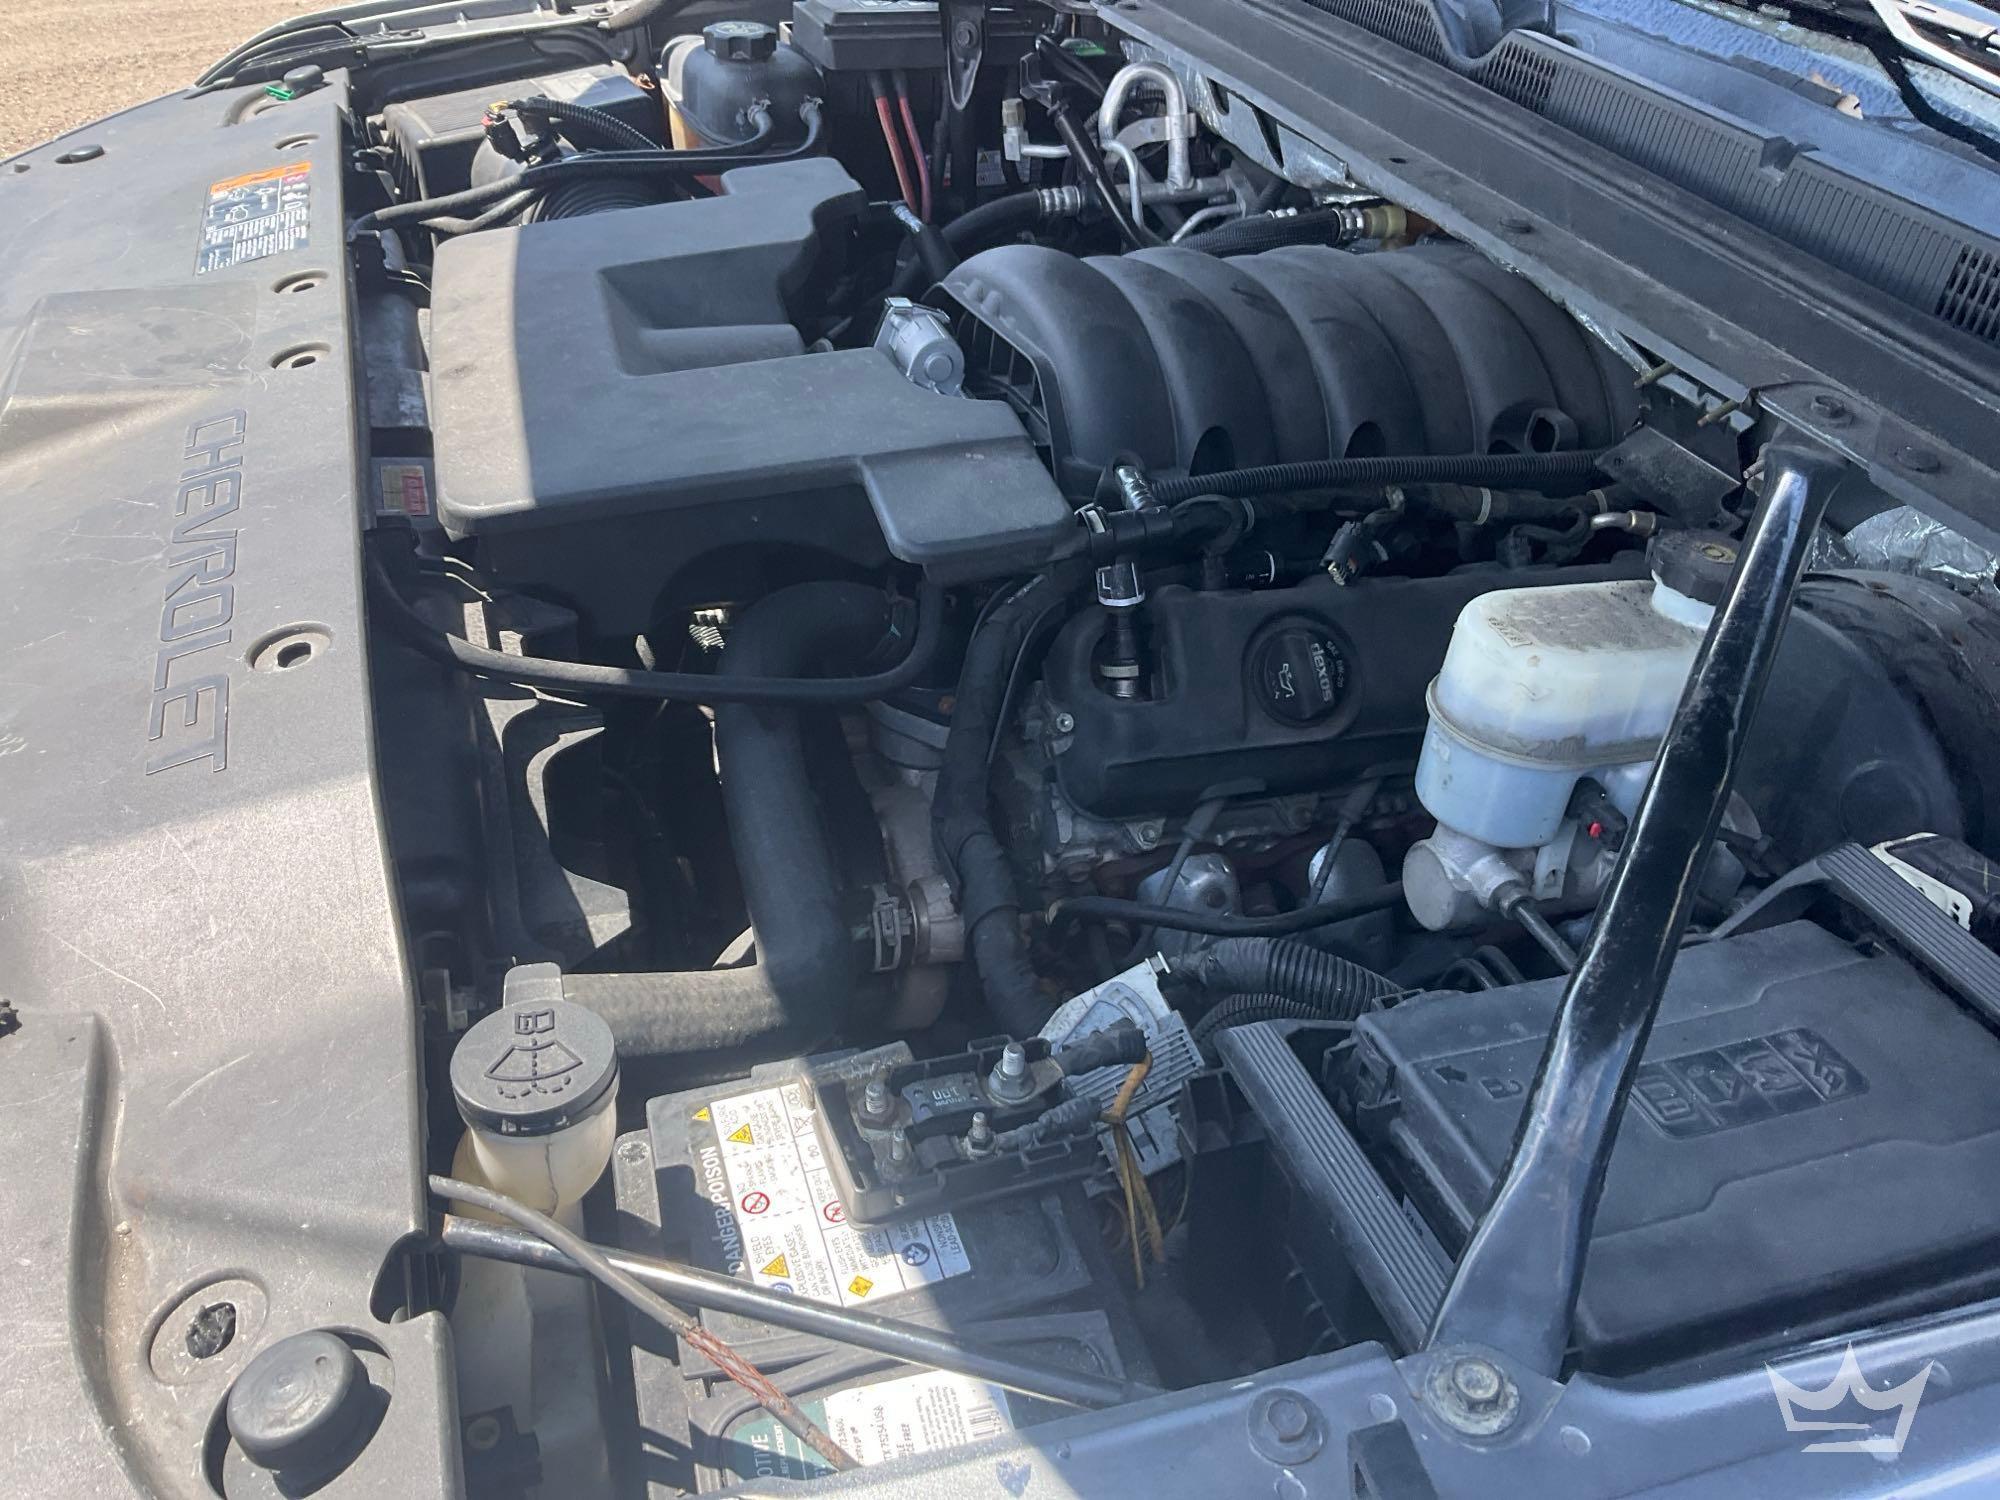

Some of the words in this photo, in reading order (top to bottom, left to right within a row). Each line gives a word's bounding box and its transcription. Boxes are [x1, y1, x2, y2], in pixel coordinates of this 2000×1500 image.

[146, 408, 247, 776] CHEVROLET
[1310, 643, 1332, 701] dexos
[750, 1235, 764, 1264] SHIELD
[762, 1234, 774, 1255] EYES
[942, 1215, 961, 1254] LEAD-ACID
[791, 1257, 808, 1298] XPLOSIVE
[774, 1424, 789, 1474] REPLACEMENT
[876, 1423, 889, 1448] 75254
